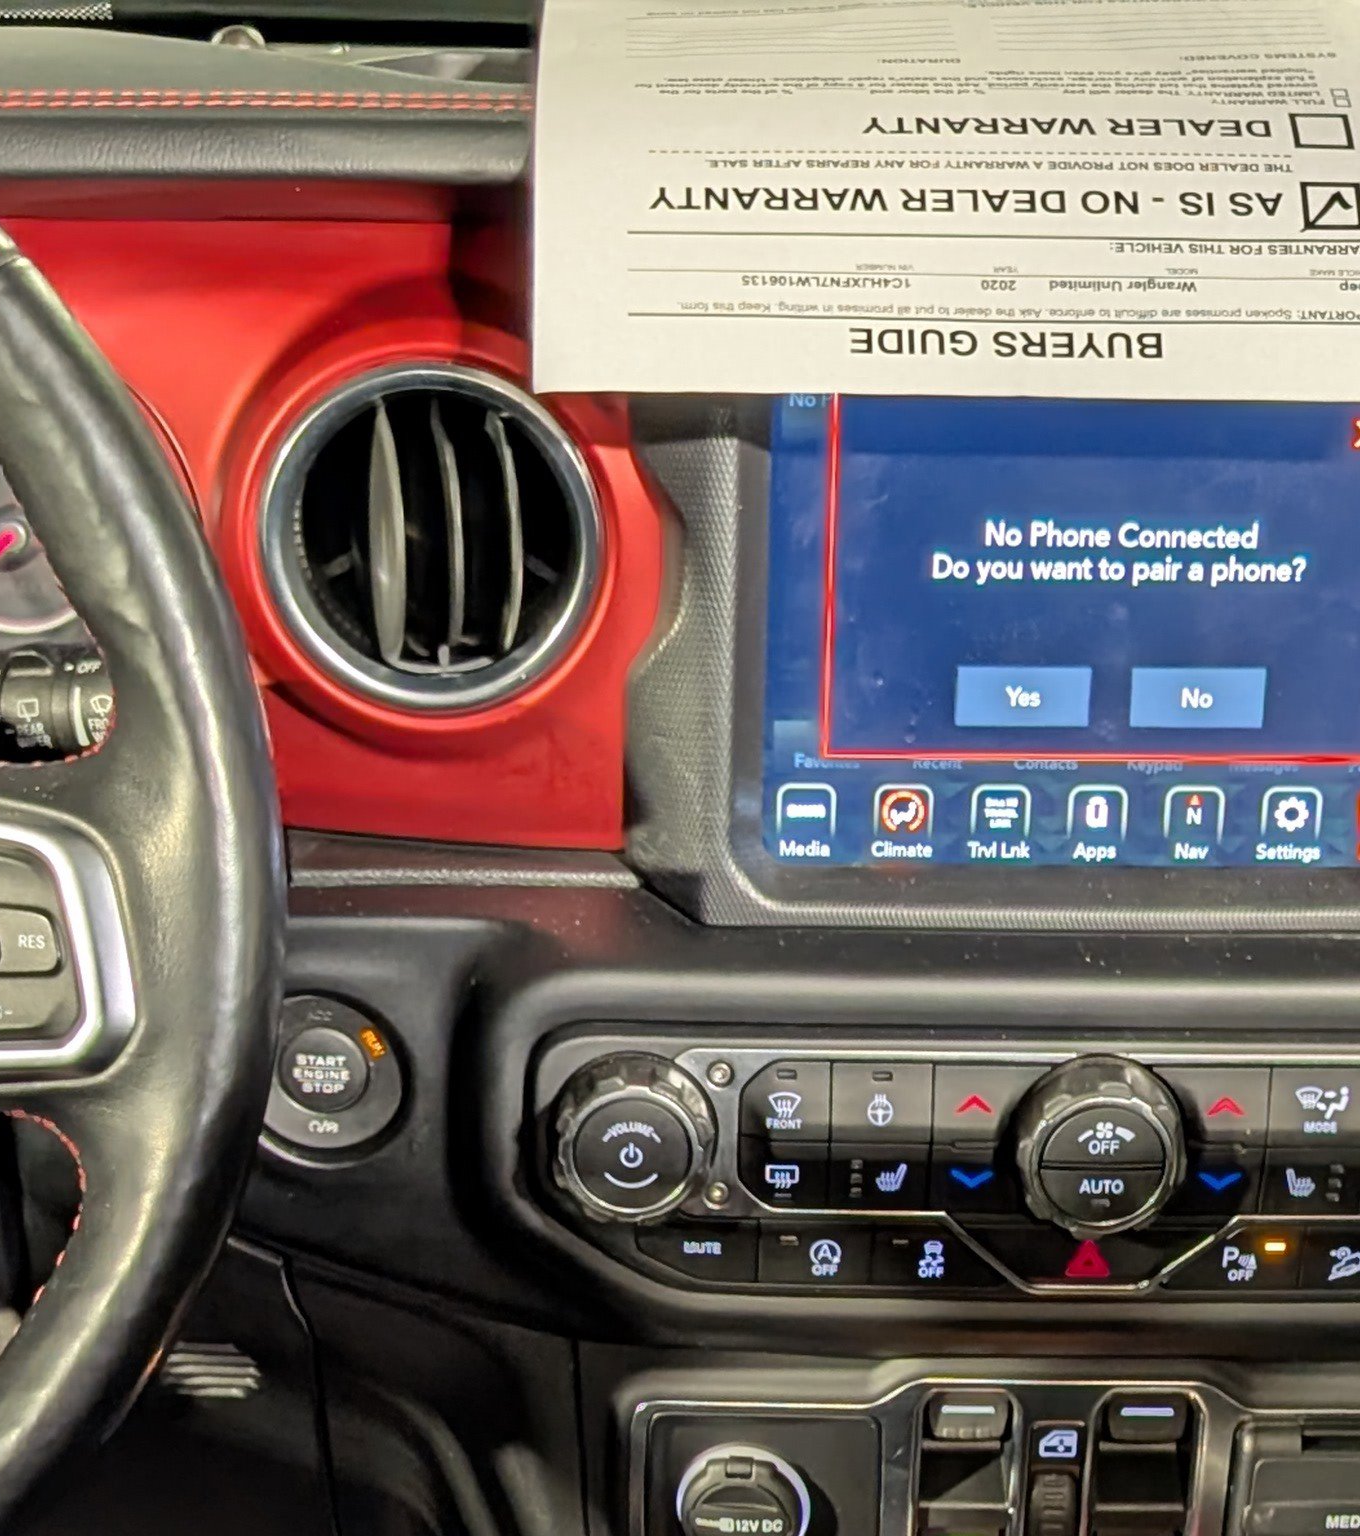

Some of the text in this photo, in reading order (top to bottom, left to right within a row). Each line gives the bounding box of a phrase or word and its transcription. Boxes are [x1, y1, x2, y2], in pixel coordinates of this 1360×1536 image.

[861, 116, 1272, 138] DEALER WARRANTY
[703, 158, 1293, 174] THE DEALER DOES NOT PROVIDE A WARRANTY FOR ANY REPAIRS AFTER SALE.
[649, 187, 1283, 216] AS IS NO DEALER WARRANTY
[1110, 242, 1184, 254] VEHICLE:
[1188, 242, 1225, 254] THIS
[1229, 243, 1263, 255] FOR
[980, 279, 1017, 292] 2020
[1049, 279, 1197, 292] Wrangler Unlimited
[952, 307, 992, 318] dealer
[995, 308, 1015, 319] the
[1161, 308, 1182, 318] are
[1185, 308, 1242, 320] promises
[1245, 308, 1292, 320] Spoken
[849, 328, 1163, 360] BUYERS GUIDE
[985, 519, 1260, 550] No Phone Connected
[932, 552, 1307, 587] Do you want to pair a phone?
[1005, 685, 1041, 708] Yes
[1181, 687, 1213, 709] No
[1186, 807, 1202, 826] N
[779, 840, 830, 858] Media
[871, 840, 933, 859] Climate
[967, 841, 1030, 859] Trvl Lnk
[1073, 842, 1117, 862] Apps
[1174, 843, 1209, 860] Nav
[1256, 843, 1321, 862] Settings
[17, 934, 45, 950] RES
[295, 1053, 346, 1067] START
[292, 1068, 351, 1081] ENGINE
[301, 1082, 345, 1094] STOP
[607, 1122, 655, 1139] VOLUME
[765, 1118, 803, 1130] FRONT
[1303, 1121, 1338, 1134] MODE
[1087, 1139, 1120, 1155] OFF
[1079, 1179, 1125, 1195] AUTO
[683, 1241, 722, 1255] MUTE
[811, 1264, 838, 1276] OFF
[918, 1266, 944, 1278] OFF
[1227, 1268, 1257, 1282] OFF
[736, 1517, 783, 1533] 12V DC
